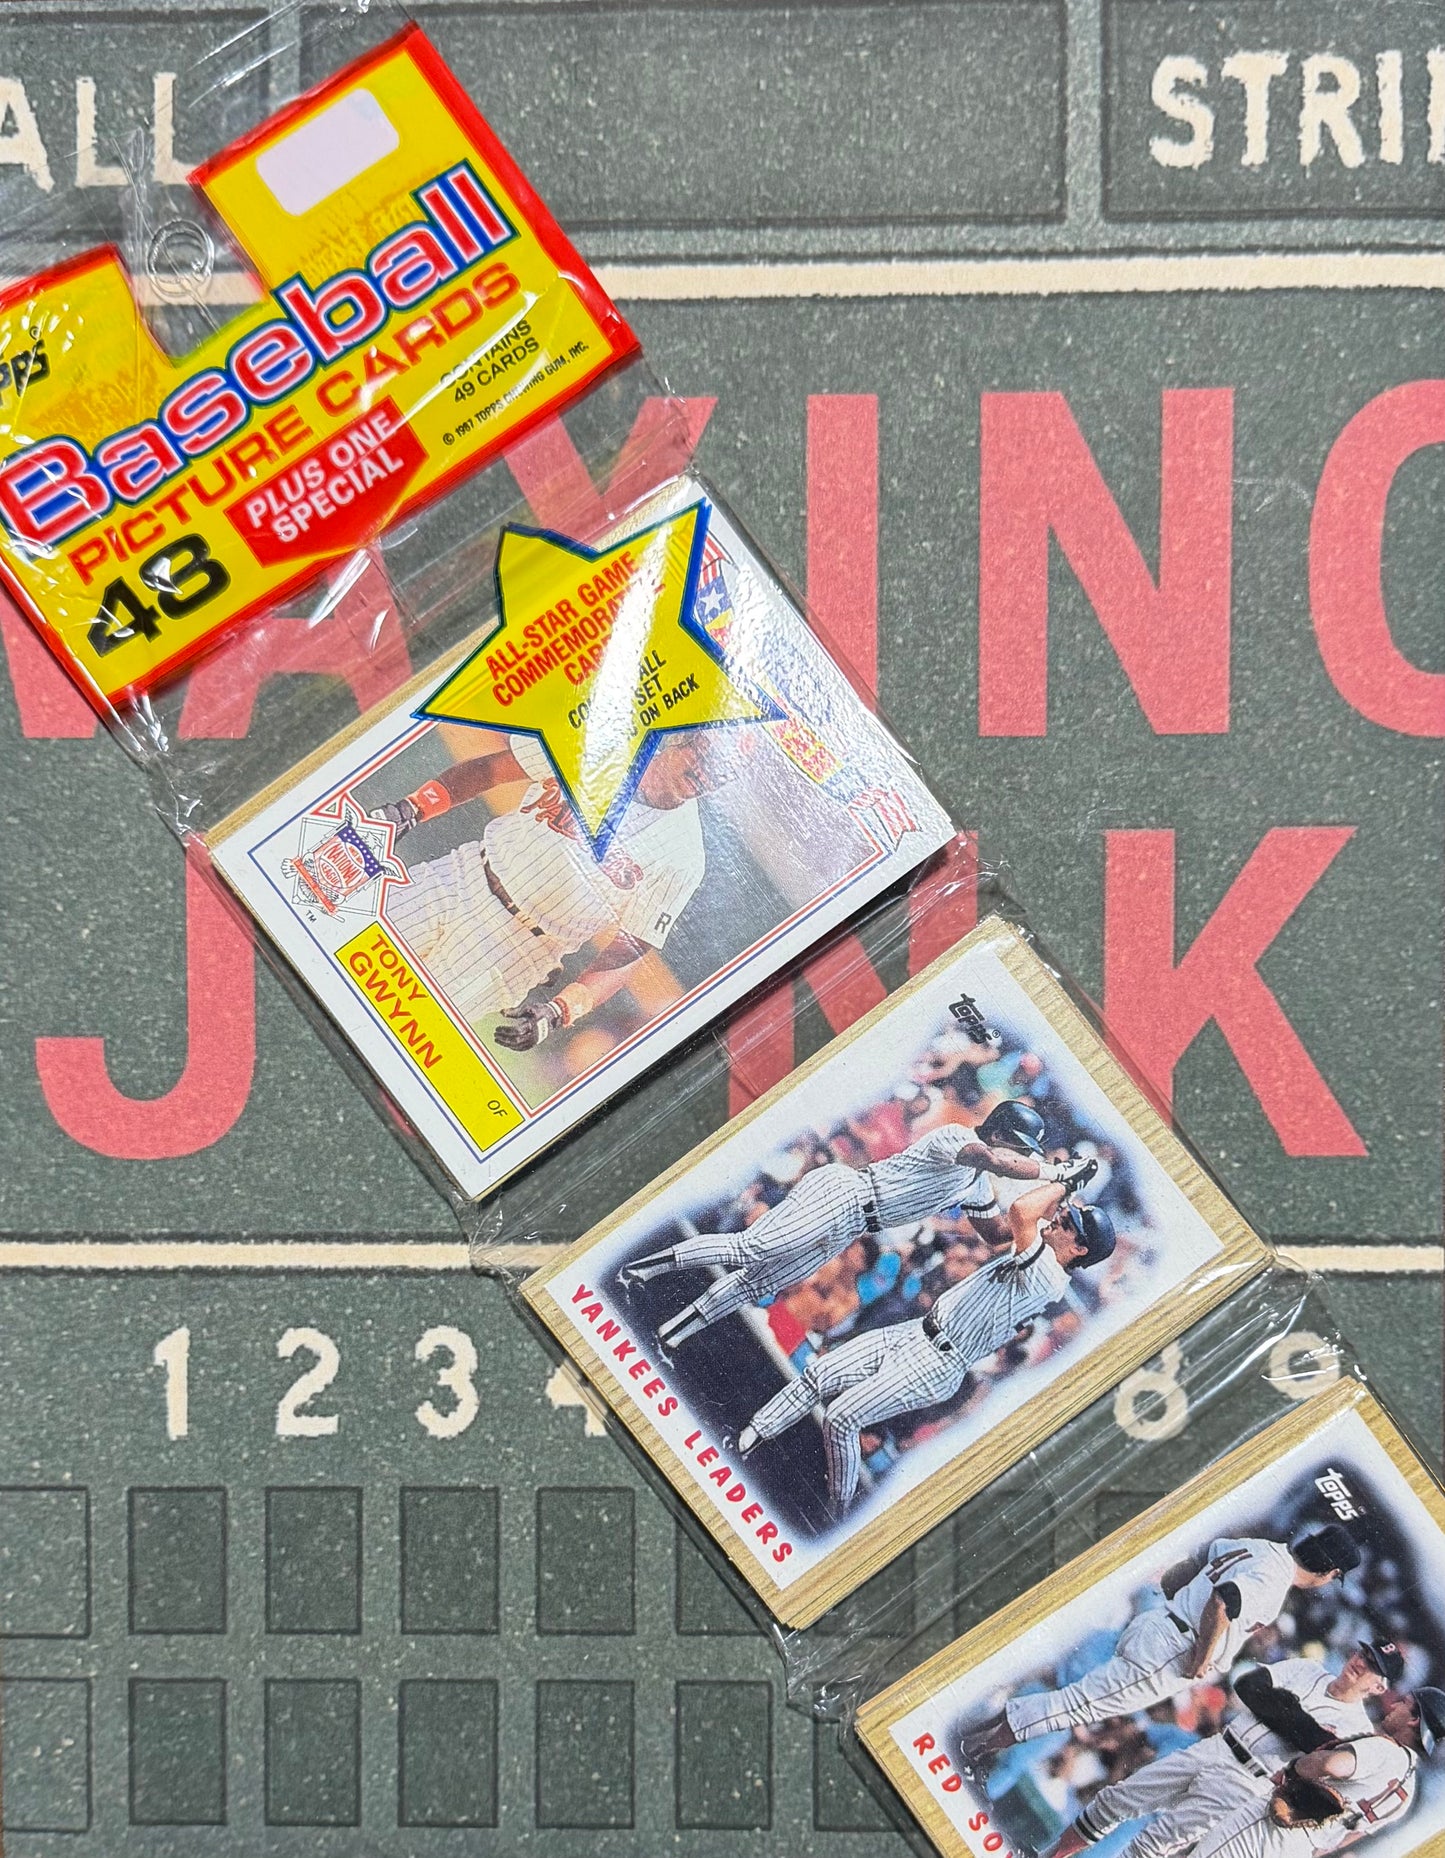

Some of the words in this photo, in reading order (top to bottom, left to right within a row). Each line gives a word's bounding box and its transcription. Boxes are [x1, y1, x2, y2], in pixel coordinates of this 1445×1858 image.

[0, 158, 520, 553] Baseball
[455, 381, 476, 402] 49
[477, 337, 540, 386] CARDS
[68, 405, 313, 585] PICTURE
[316, 262, 521, 417] CARDS
[246, 458, 325, 528] PLUS
[331, 410, 394, 470] ONE
[455, 419, 475, 437] 1987
[474, 399, 504, 423] TOPPS
[271, 446, 404, 543] SPECIAL
[88, 533, 231, 657] 48
[485, 599, 580, 681] ALL-STAR
[577, 551, 641, 608] GAME
[634, 673, 664, 706] SET
[639, 650, 667, 681] ALL
[639, 702, 661, 727] ON
[662, 673, 700, 710] BACK
[349, 951, 444, 1069] GWYNN
[370, 933, 430, 1001] TONY
[487, 1099, 509, 1119] OF
[153, 1326, 191, 1440] 1
[276, 1326, 340, 1438] 2
[415, 1325, 479, 1440] 3
[571, 1284, 679, 1417] YANKEES
[684, 1429, 793, 1563] LEADERS
[912, 1732, 963, 1793] RED
[968, 1811, 1014, 1858] SO
